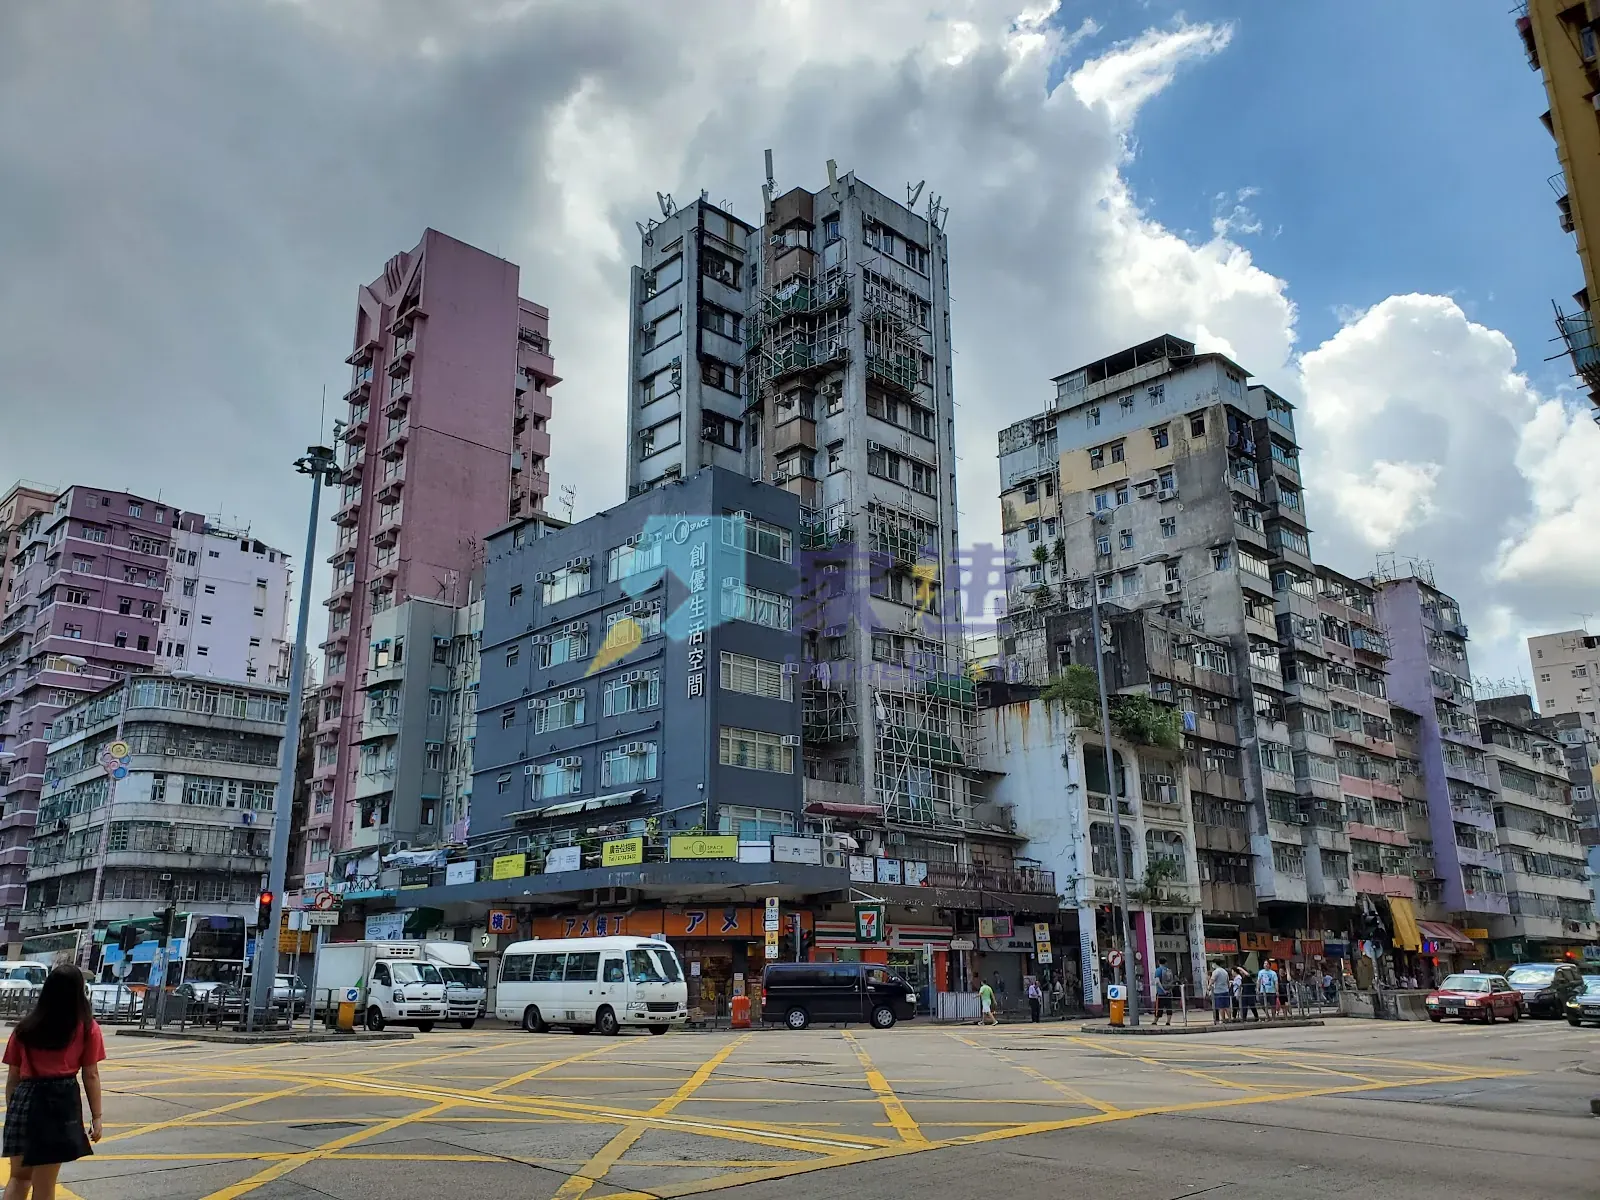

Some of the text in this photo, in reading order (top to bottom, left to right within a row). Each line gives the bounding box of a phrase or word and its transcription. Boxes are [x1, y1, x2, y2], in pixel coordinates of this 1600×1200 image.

[690, 518, 709, 532] SPACE
[687, 541, 706, 700] 創優生活空間
